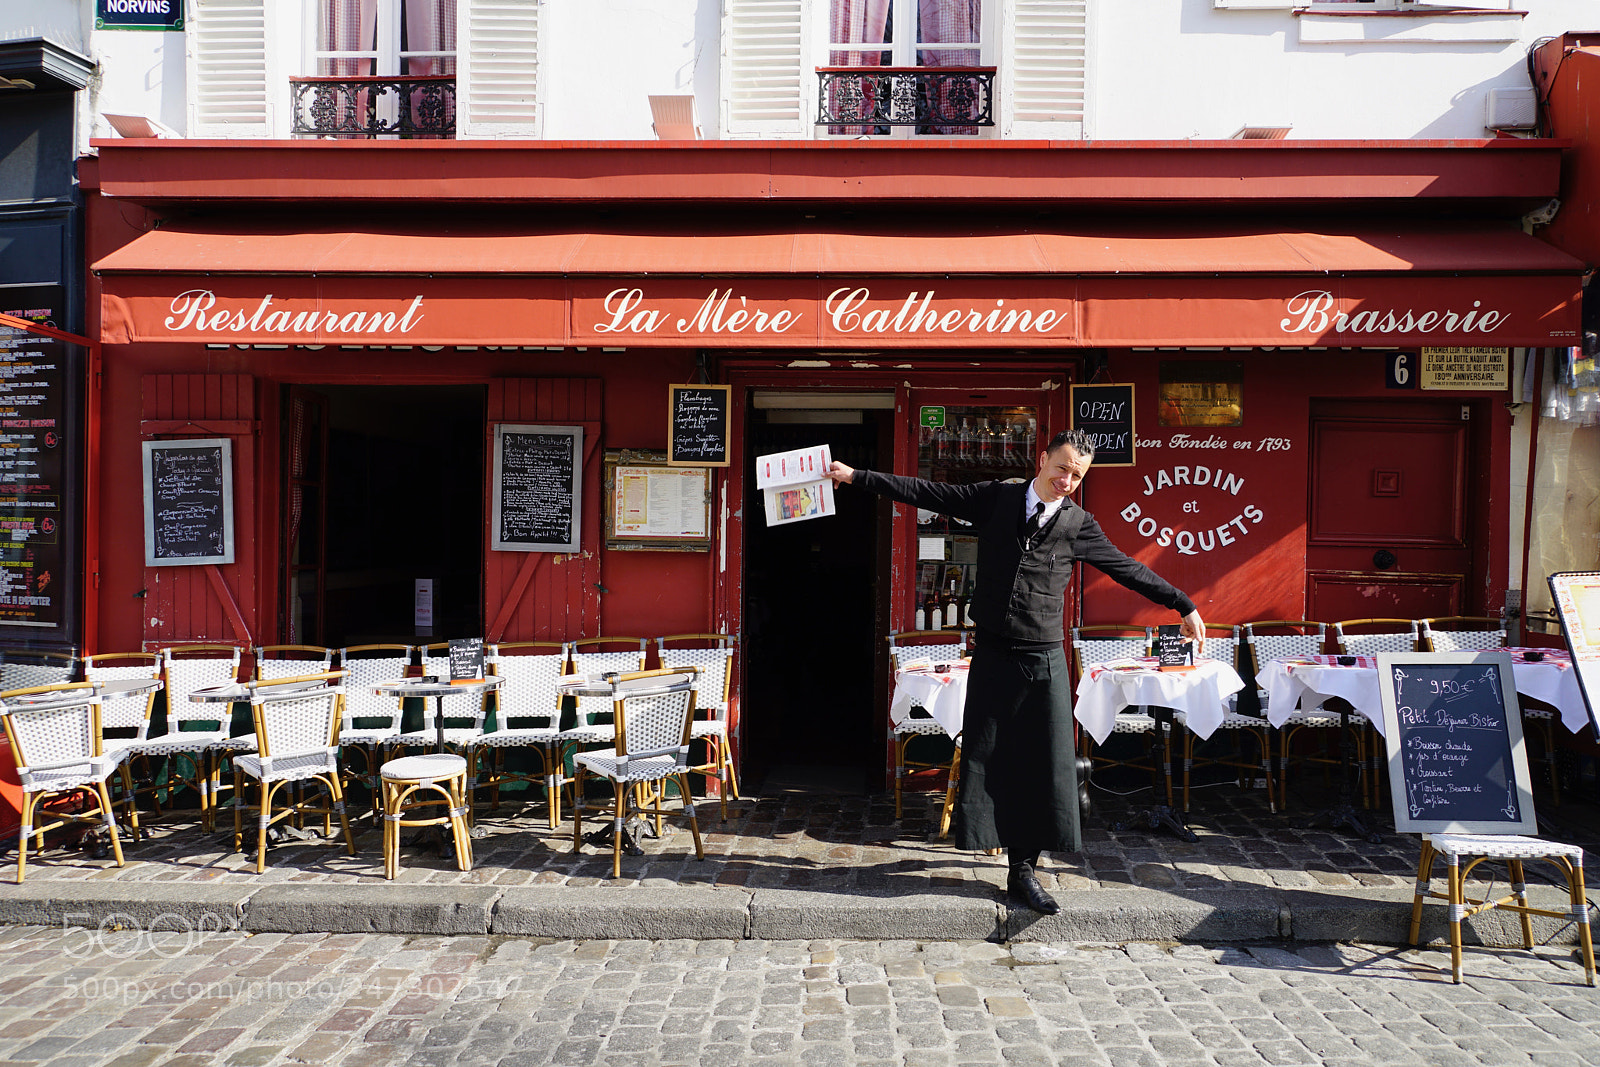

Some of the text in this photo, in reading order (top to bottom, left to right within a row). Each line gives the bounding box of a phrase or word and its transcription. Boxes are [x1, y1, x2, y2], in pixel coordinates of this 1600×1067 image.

[107, 0, 171, 14] NORVINS
[164, 289, 424, 333] Restaurant
[594, 288, 803, 333] La Mère
[825, 287, 1068, 333] Catherine
[1280, 290, 1511, 333] Brasserie
[1394, 354, 1409, 385] 6
[1428, 355, 1502, 363] ET SUR LA BUTTE NAQUIT AINSI
[1080, 401, 1125, 420] OPEN
[1168, 433, 1227, 450] Fondée
[1232, 440, 1252, 450] en
[1256, 437, 1291, 452] 1793
[1143, 465, 1245, 496] JARDIN
[1182, 500, 1200, 513] et
[1120, 502, 1264, 556] BOSQUETS
[1399, 706, 1429, 724] Petit
[1468, 713, 1500, 727] Bistro
[1473, 784, 1482, 793] et
